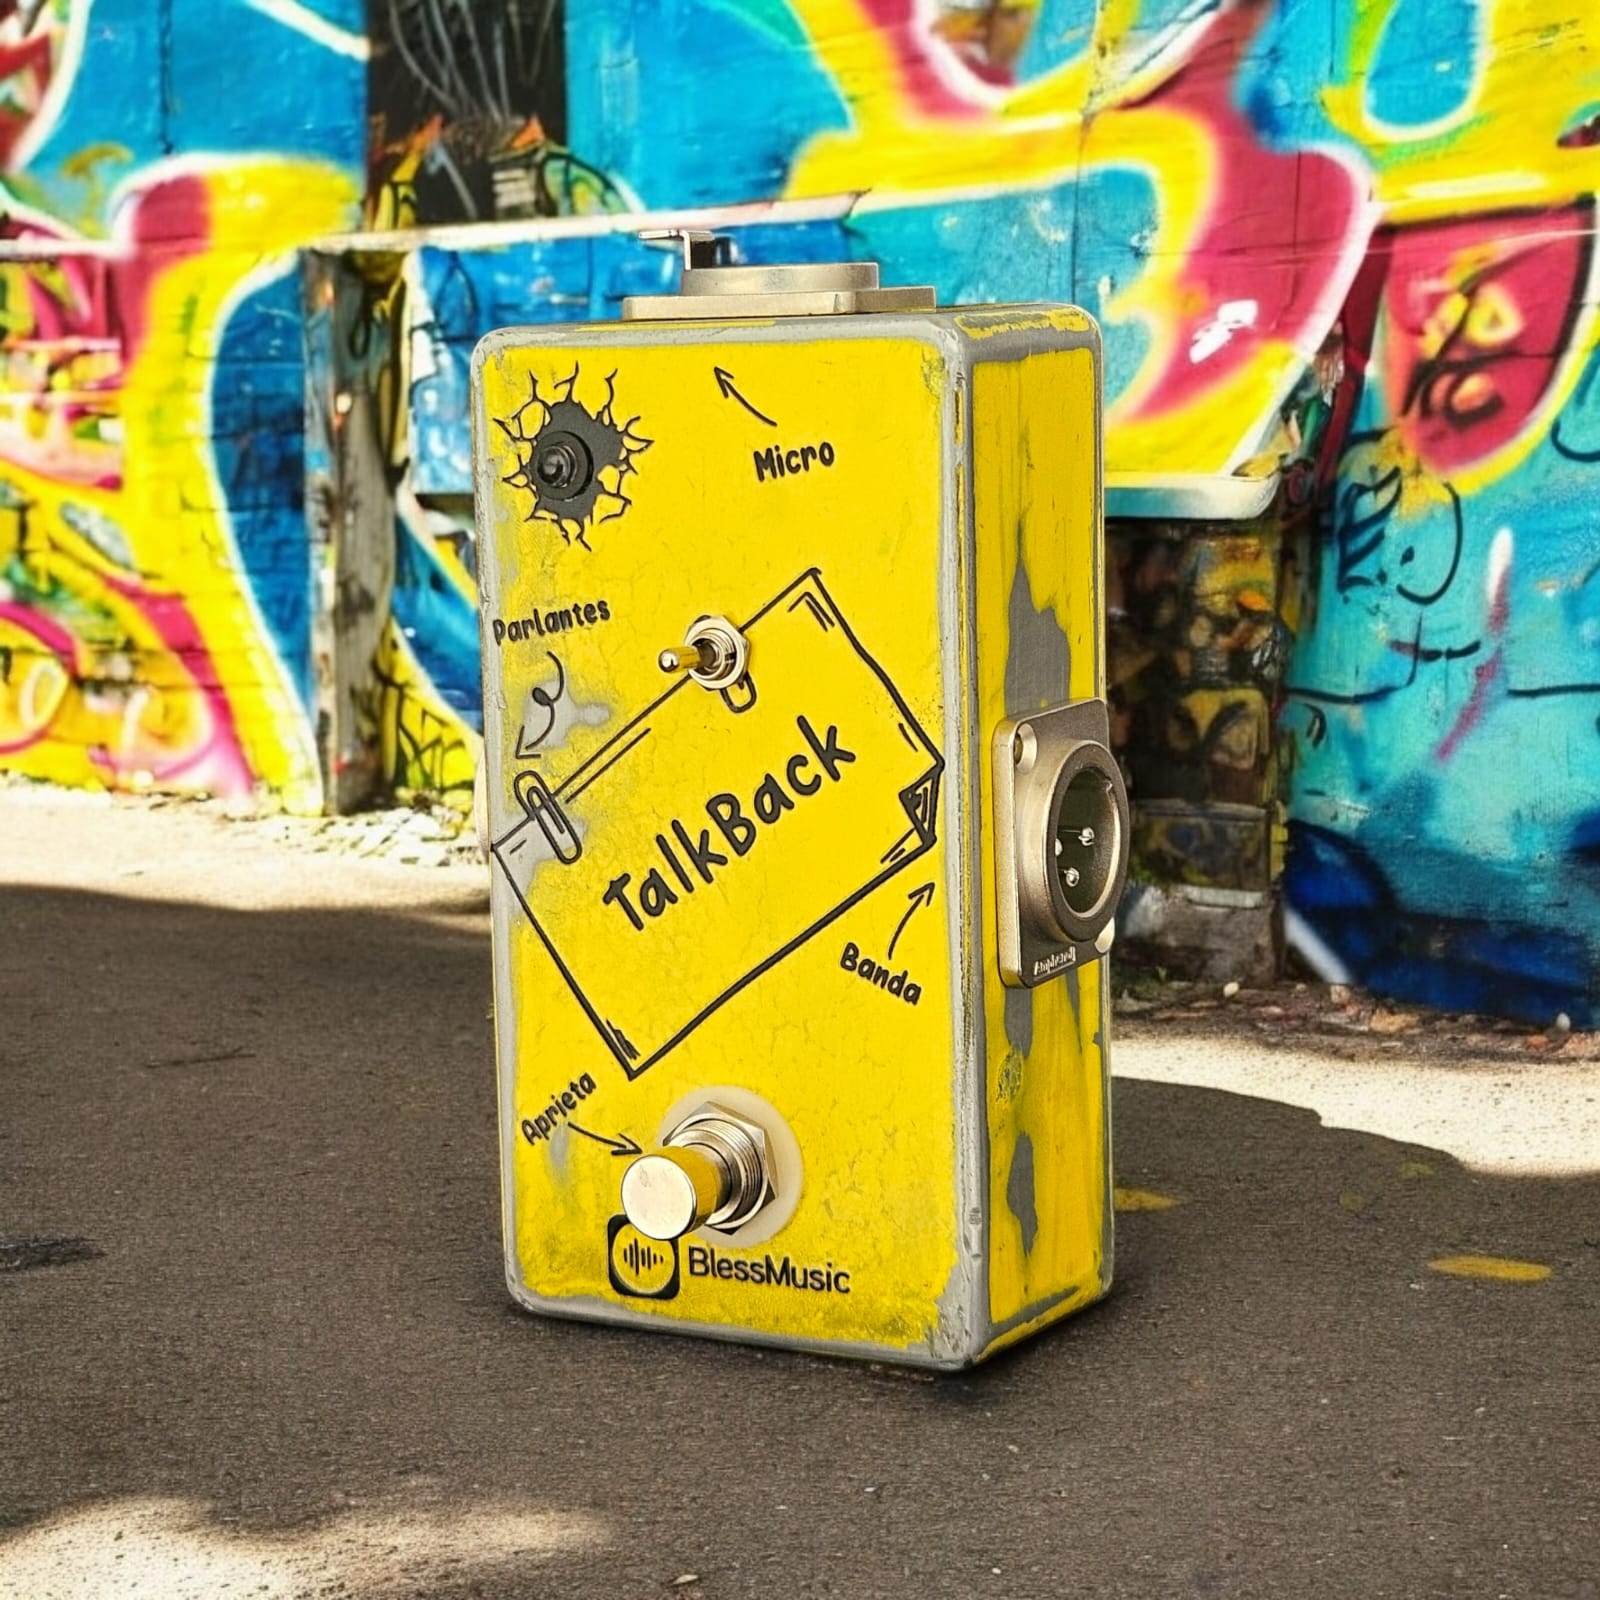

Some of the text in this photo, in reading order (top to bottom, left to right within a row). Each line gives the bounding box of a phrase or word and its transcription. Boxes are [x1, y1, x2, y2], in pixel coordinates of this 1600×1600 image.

[753, 441, 835, 483] Micro
[492, 600, 611, 646] Parlantes
[602, 715, 856, 932] TalkBack
[839, 942, 922, 1005] Banda
[521, 1072, 597, 1146] Aprieta
[687, 1245, 851, 1294] BlessMusic
